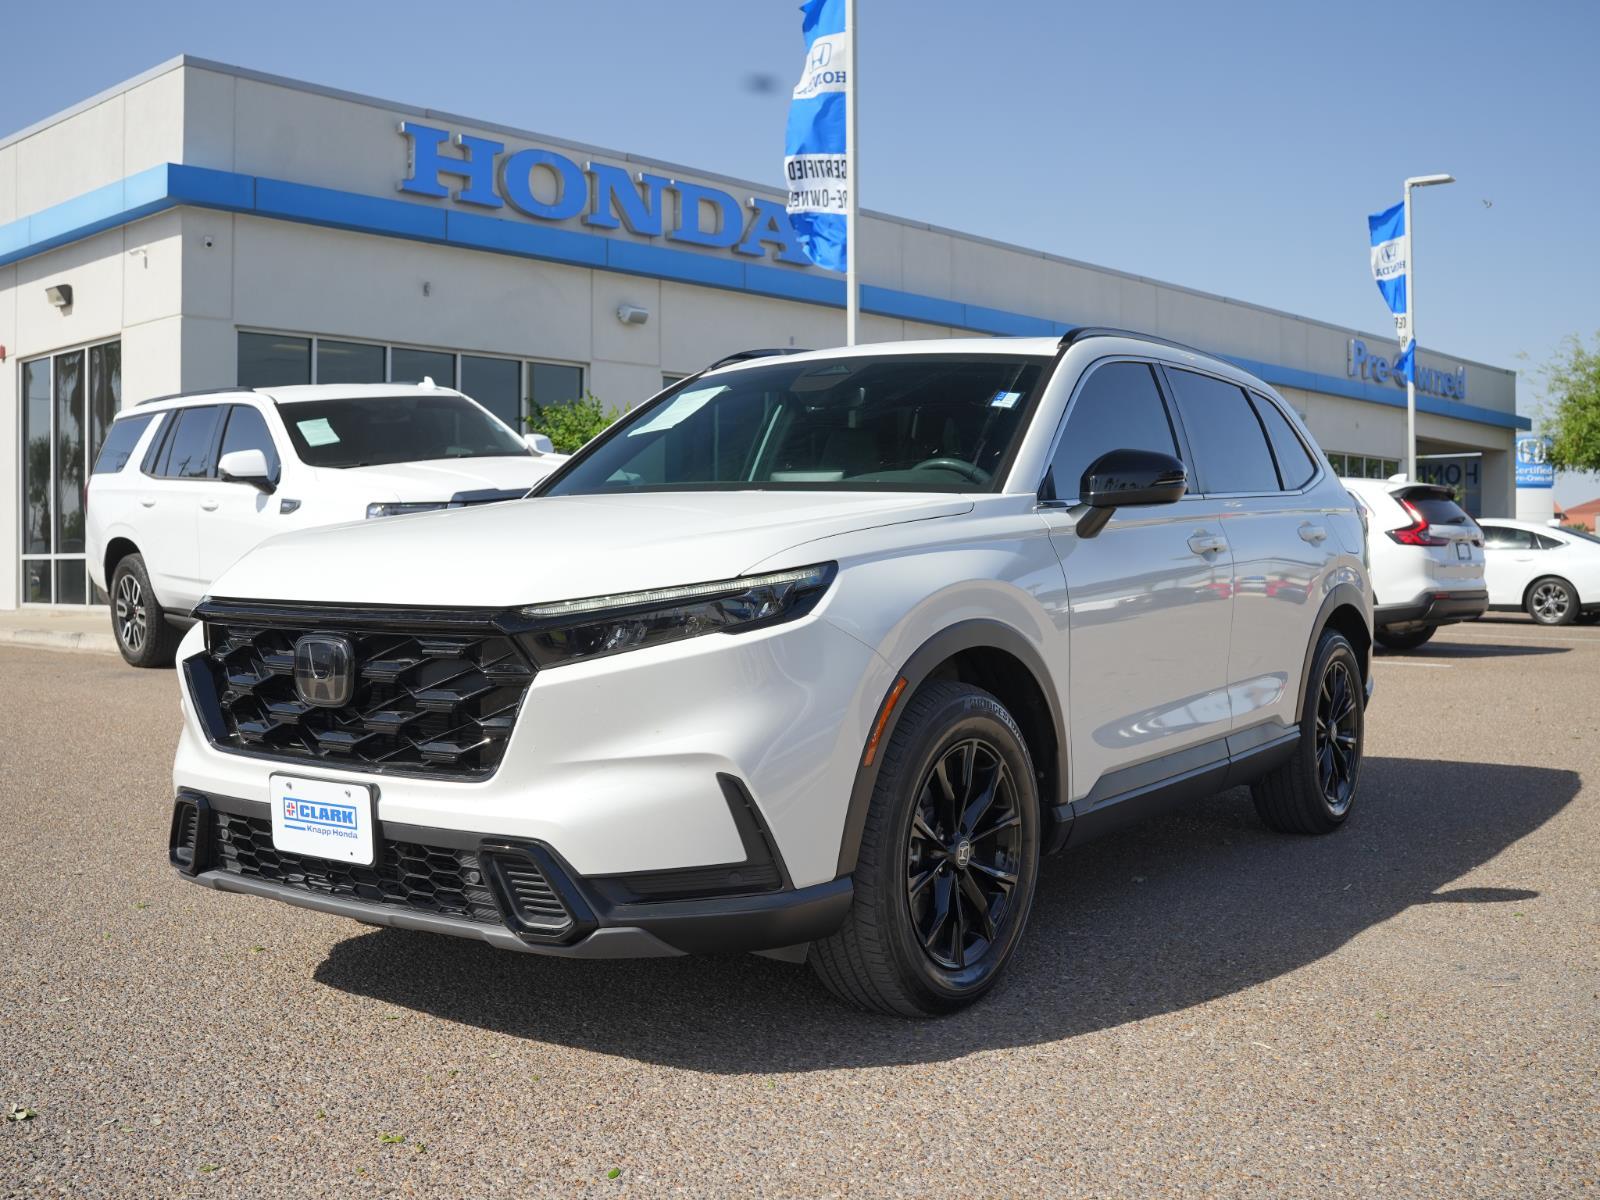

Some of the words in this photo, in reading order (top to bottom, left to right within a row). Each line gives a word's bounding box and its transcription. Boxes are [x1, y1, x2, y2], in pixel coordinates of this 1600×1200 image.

[398, 121, 813, 267] HONDA
[299, 804, 354, 825] CLARK
[306, 824, 332, 837] Knapp
[332, 829, 358, 840] Honda
